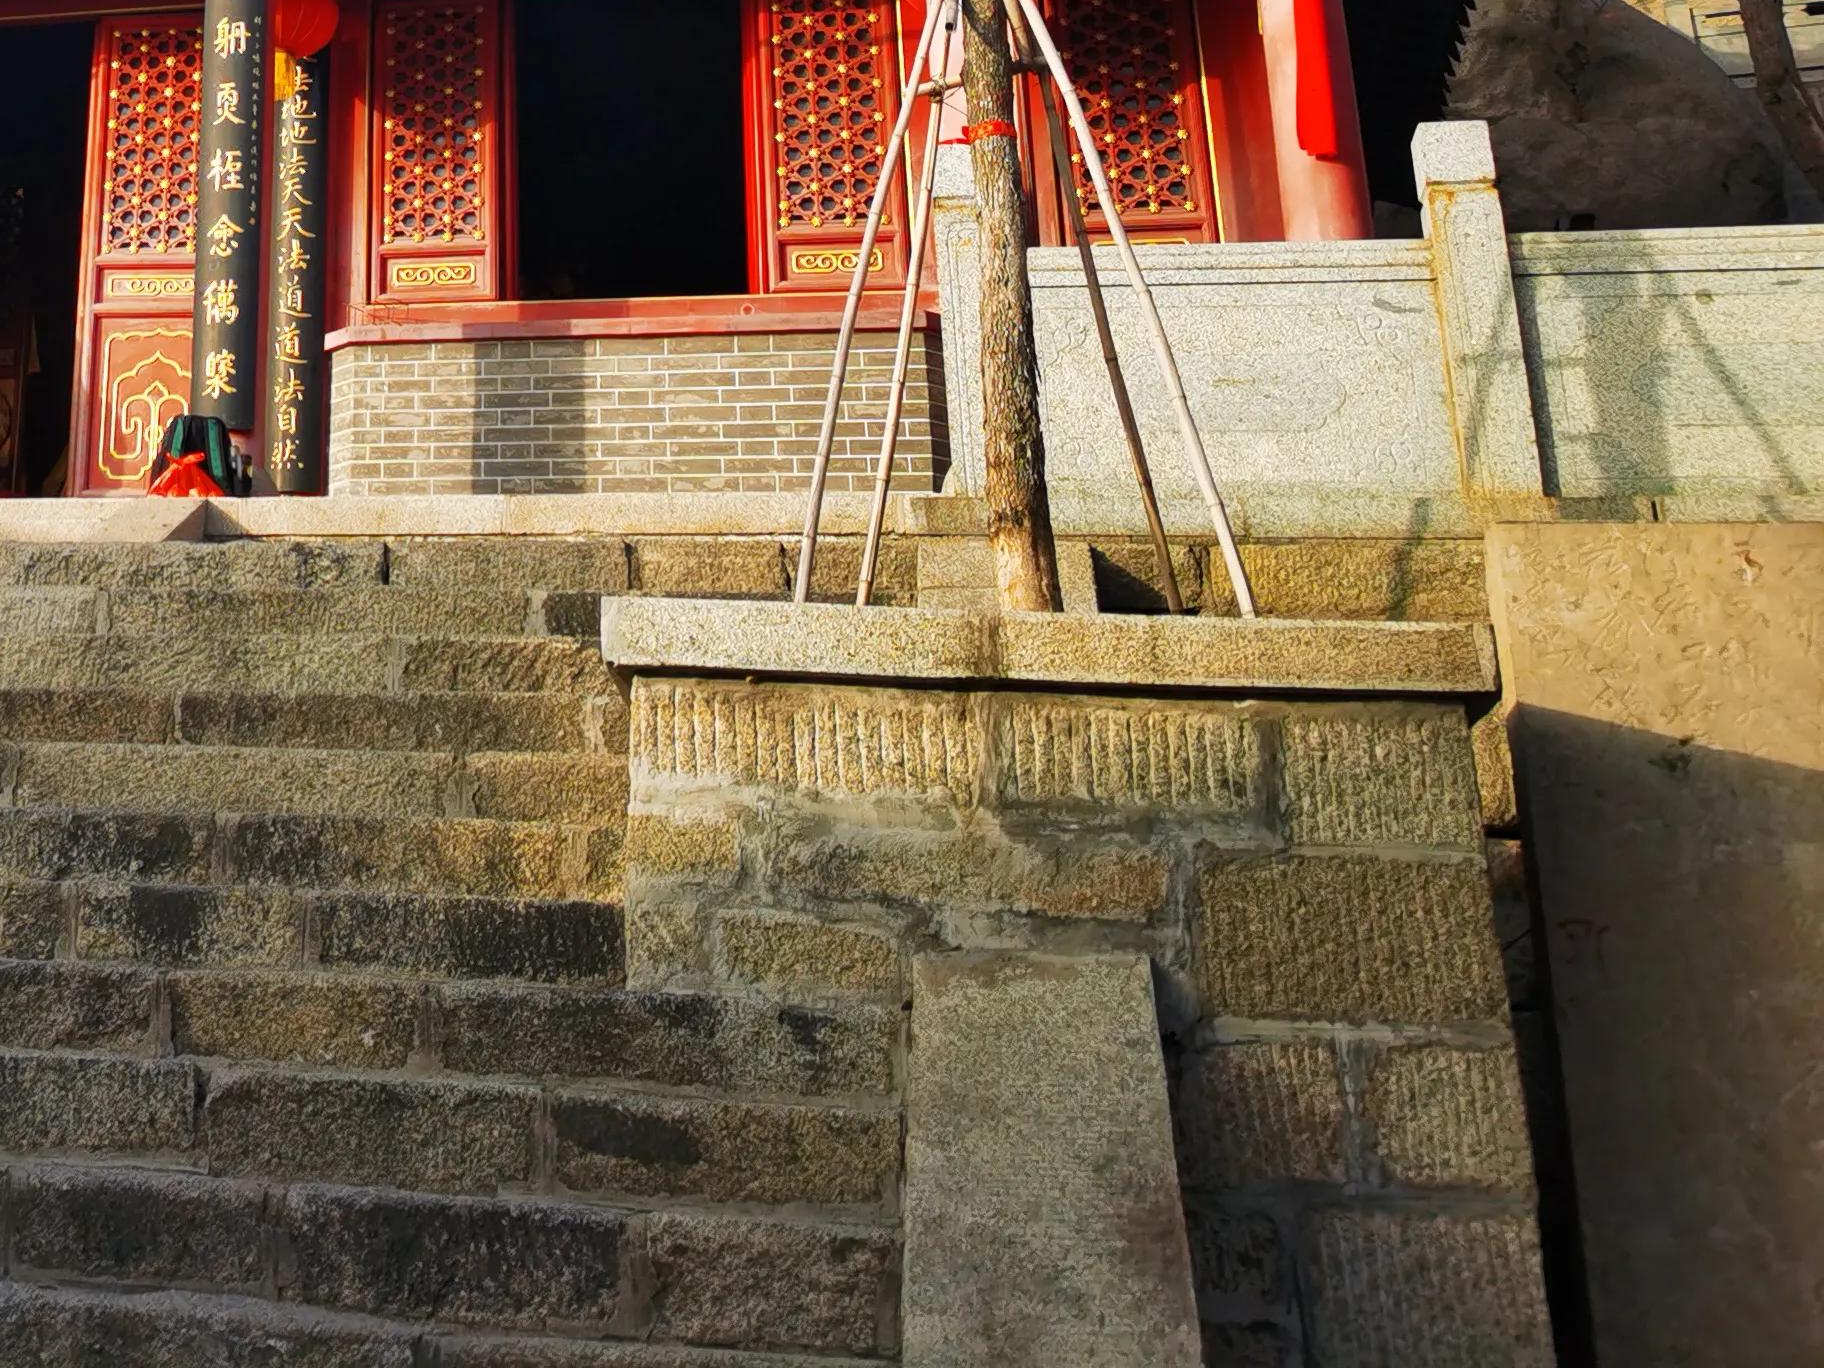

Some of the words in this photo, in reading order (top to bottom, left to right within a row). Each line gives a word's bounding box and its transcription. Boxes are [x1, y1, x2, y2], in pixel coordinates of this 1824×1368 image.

[270, 56, 317, 470] 法地地法天天法道道法自然
